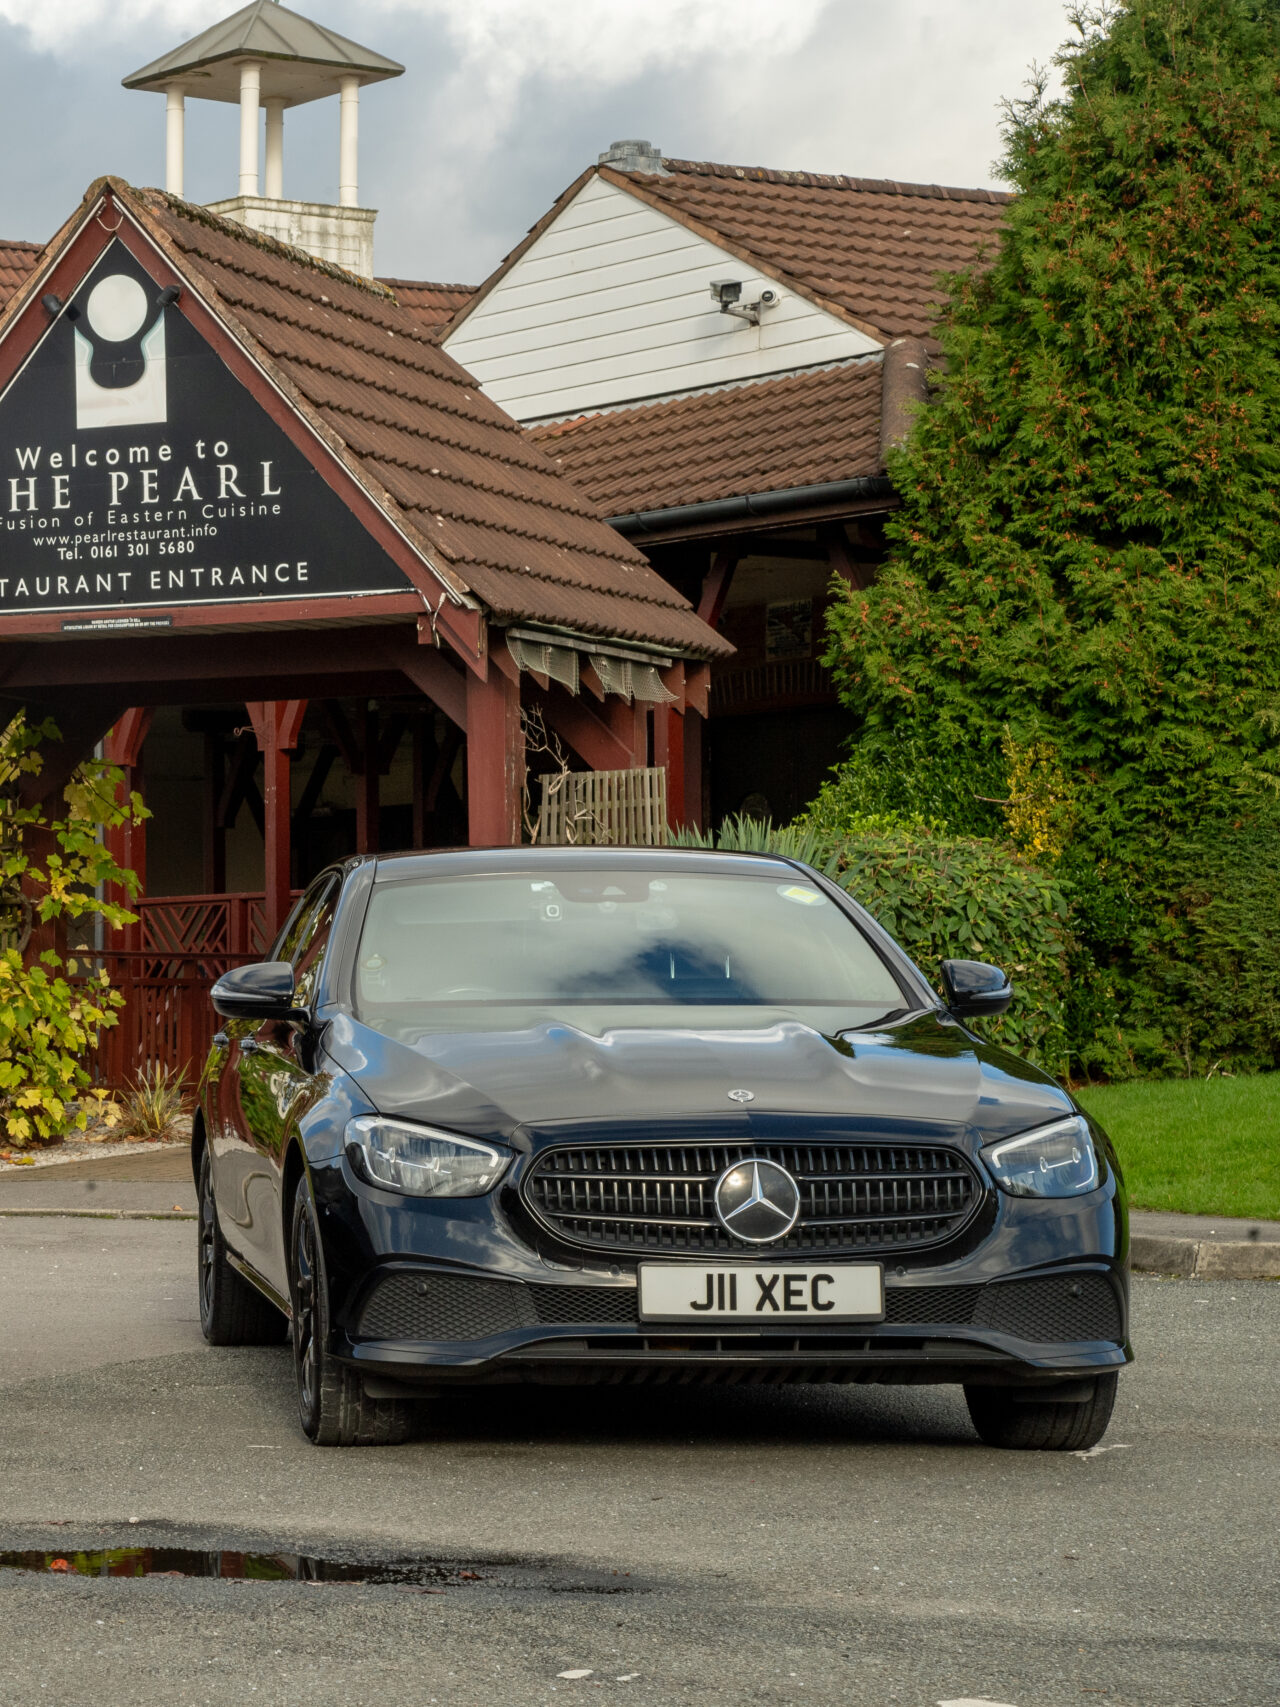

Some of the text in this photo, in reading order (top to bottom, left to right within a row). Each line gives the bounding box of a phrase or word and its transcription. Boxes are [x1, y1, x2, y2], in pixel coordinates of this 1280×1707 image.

[15, 439, 229, 471] Welcome to
[108, 461, 282, 506] PEARL
[74, 511, 94, 527] of
[107, 509, 187, 525] Eastern
[201, 502, 281, 519] Cuisine
[33, 523, 218, 547] www.pearlrestaurant.info
[57, 540, 195, 561] Tel. 0161 301 5680
[150, 561, 308, 590] ENTRANCE
[755, 1273, 836, 1312] XEC
